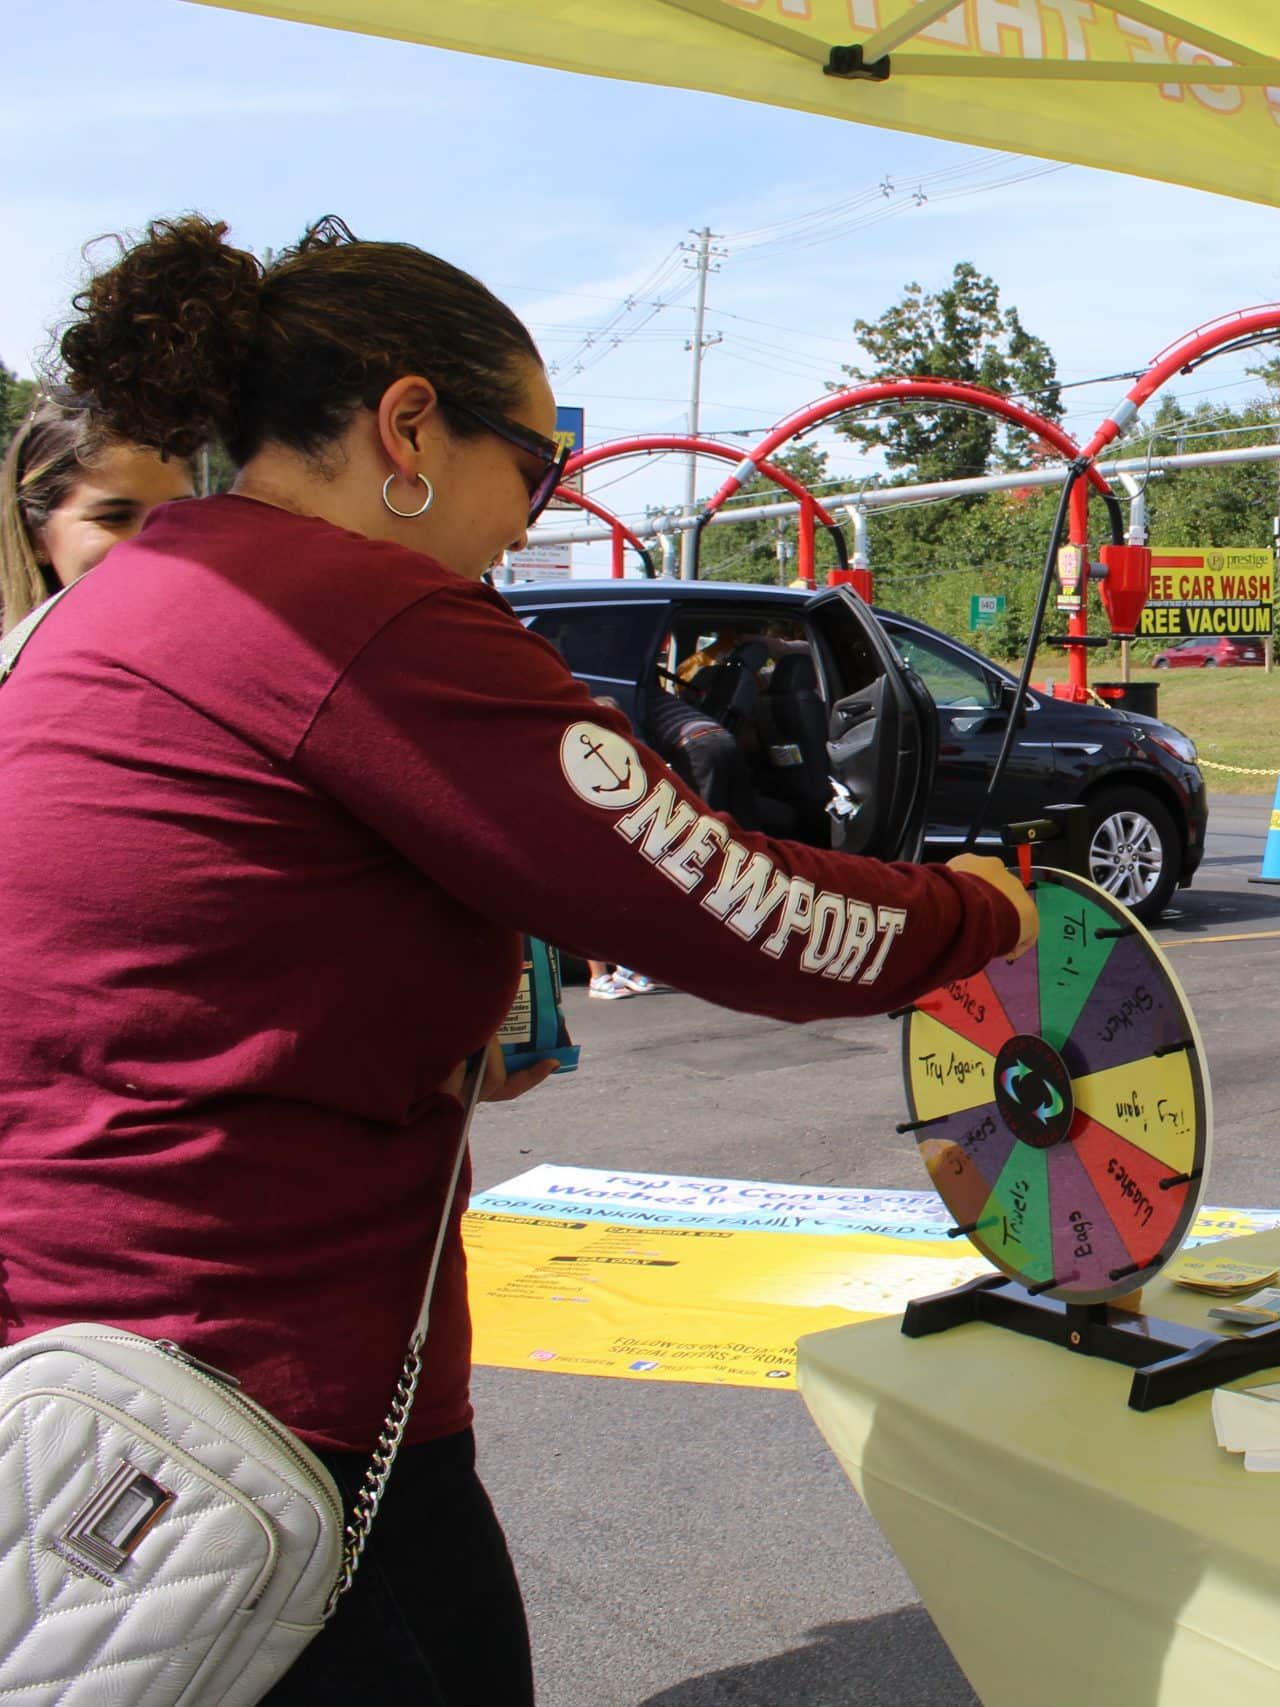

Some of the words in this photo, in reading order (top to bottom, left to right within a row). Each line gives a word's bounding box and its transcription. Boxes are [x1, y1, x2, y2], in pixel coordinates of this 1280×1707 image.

[1227, 554, 1269, 569] prestige
[1149, 575, 1173, 600] EE
[1179, 575, 1217, 600] CAR
[1220, 575, 1270, 600] WASH
[1140, 608, 1182, 634] REE
[1185, 607, 1271, 633] VACUUM
[613, 778, 907, 985] NEWPORT
[919, 1053, 945, 1085] Try
[480, 1198, 528, 1208] TOP
[556, 1205, 670, 1223] RANKING
